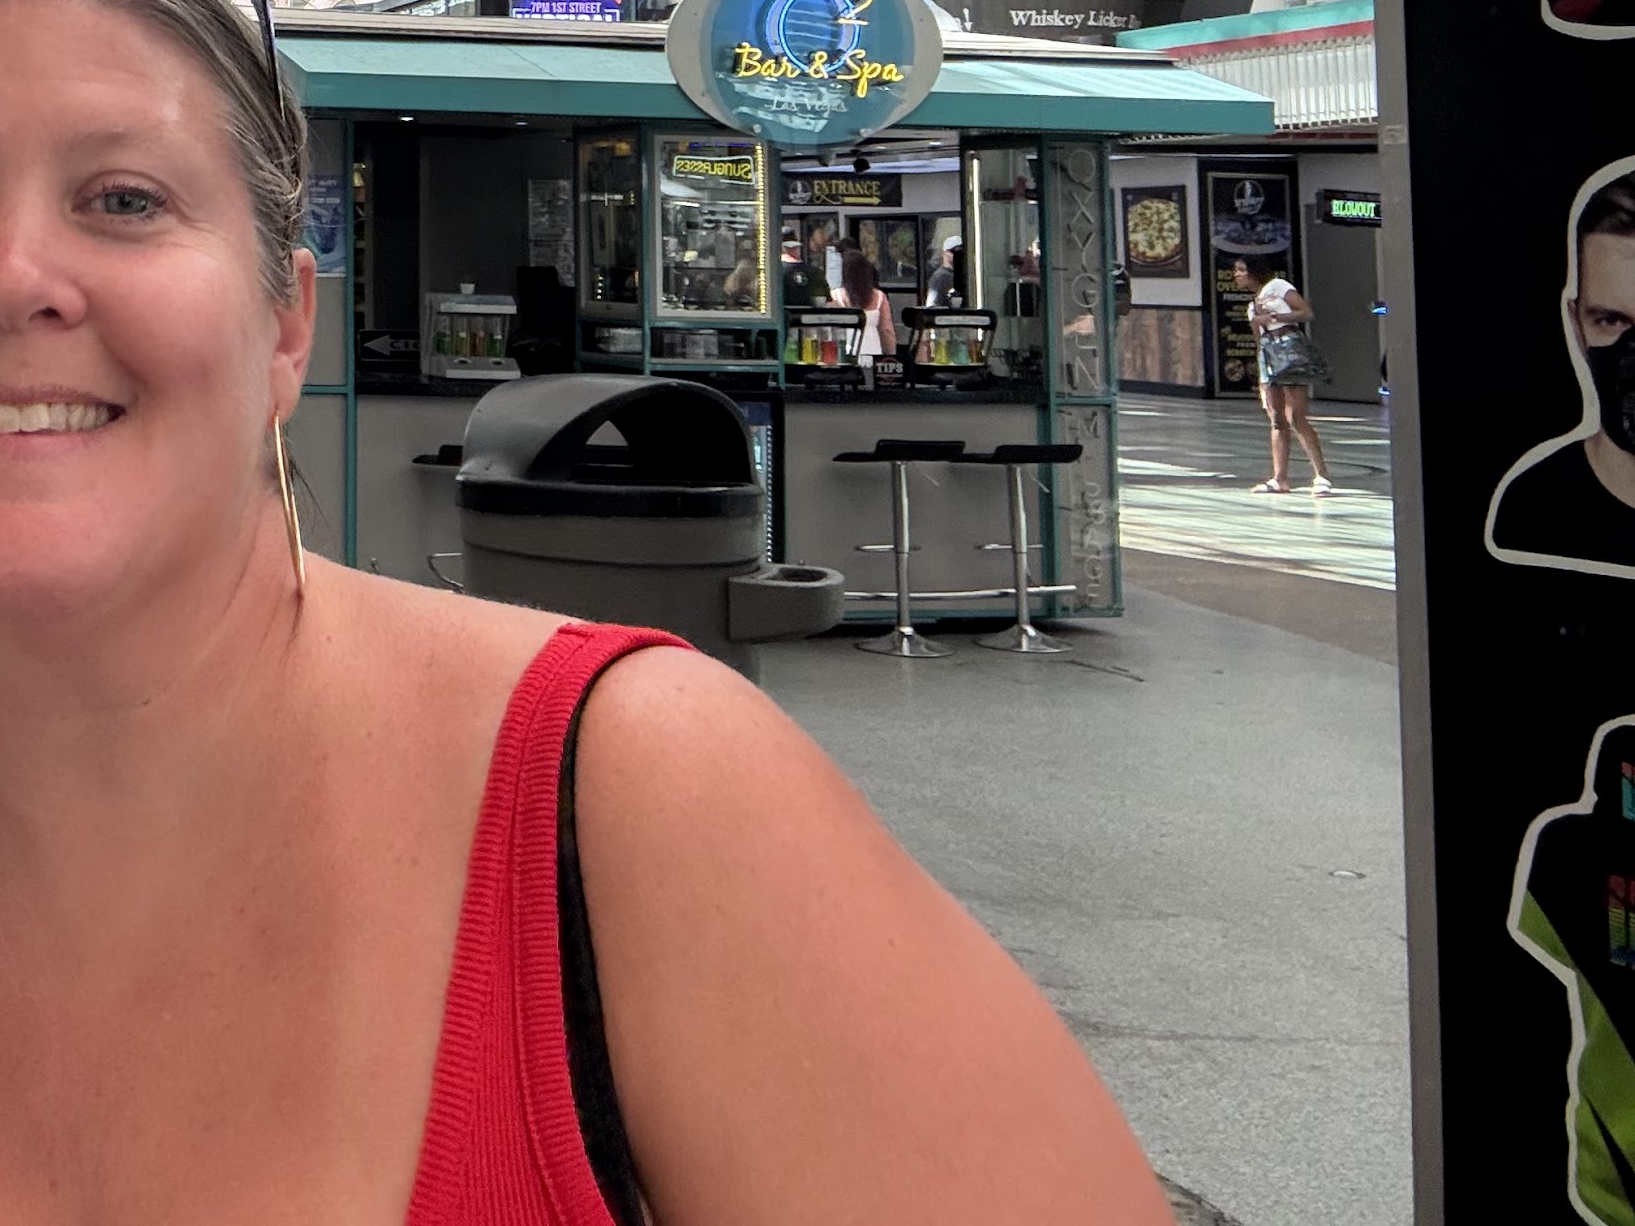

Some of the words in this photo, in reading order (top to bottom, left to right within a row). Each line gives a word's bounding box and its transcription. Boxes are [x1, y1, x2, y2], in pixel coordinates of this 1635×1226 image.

[531, 2, 550, 13] 7PM
[552, 2, 567, 13] 1ST
[569, 2, 602, 13] STREET
[1010, 9, 1085, 29] Whiskey
[1087, 10, 1127, 28] Licker
[734, 42, 802, 78] Bar
[809, 51, 829, 79] &
[836, 49, 904, 98] Spa
[765, 95, 799, 112] Las
[804, 96, 850, 118] Vegas
[814, 179, 881, 198] ENTRANCE
[1331, 199, 1377, 220] BLOWOUT
[876, 362, 903, 374] TIPS
